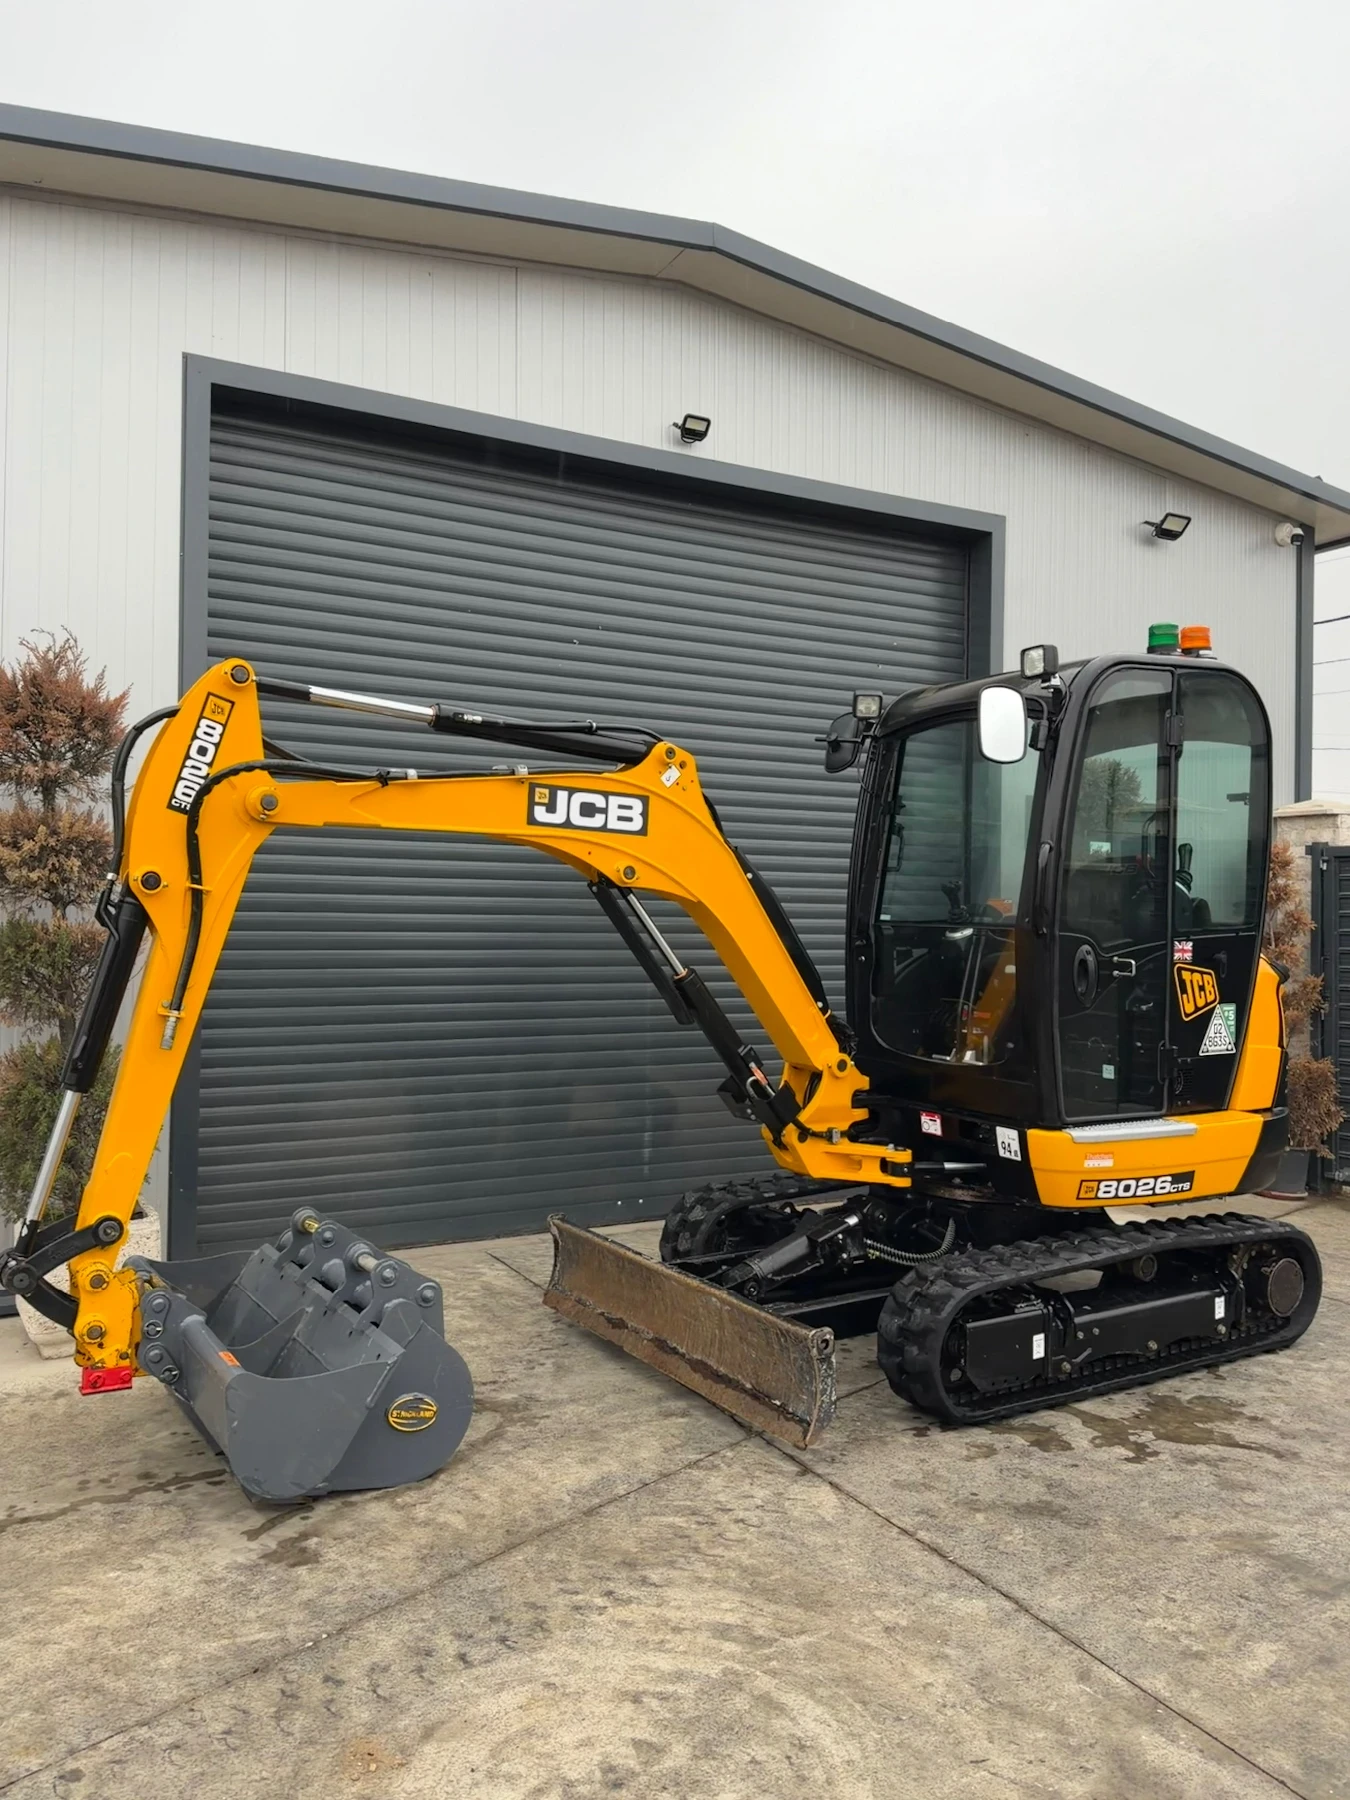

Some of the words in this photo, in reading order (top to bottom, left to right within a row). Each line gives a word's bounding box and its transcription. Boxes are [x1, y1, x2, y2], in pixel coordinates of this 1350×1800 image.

[534, 790, 643, 831] JCB
[1181, 970, 1215, 1014] JCB
[1001, 1141, 1012, 1156] 94
[1097, 1176, 1172, 1198] 8026
[1170, 1182, 1191, 1193] CTS
